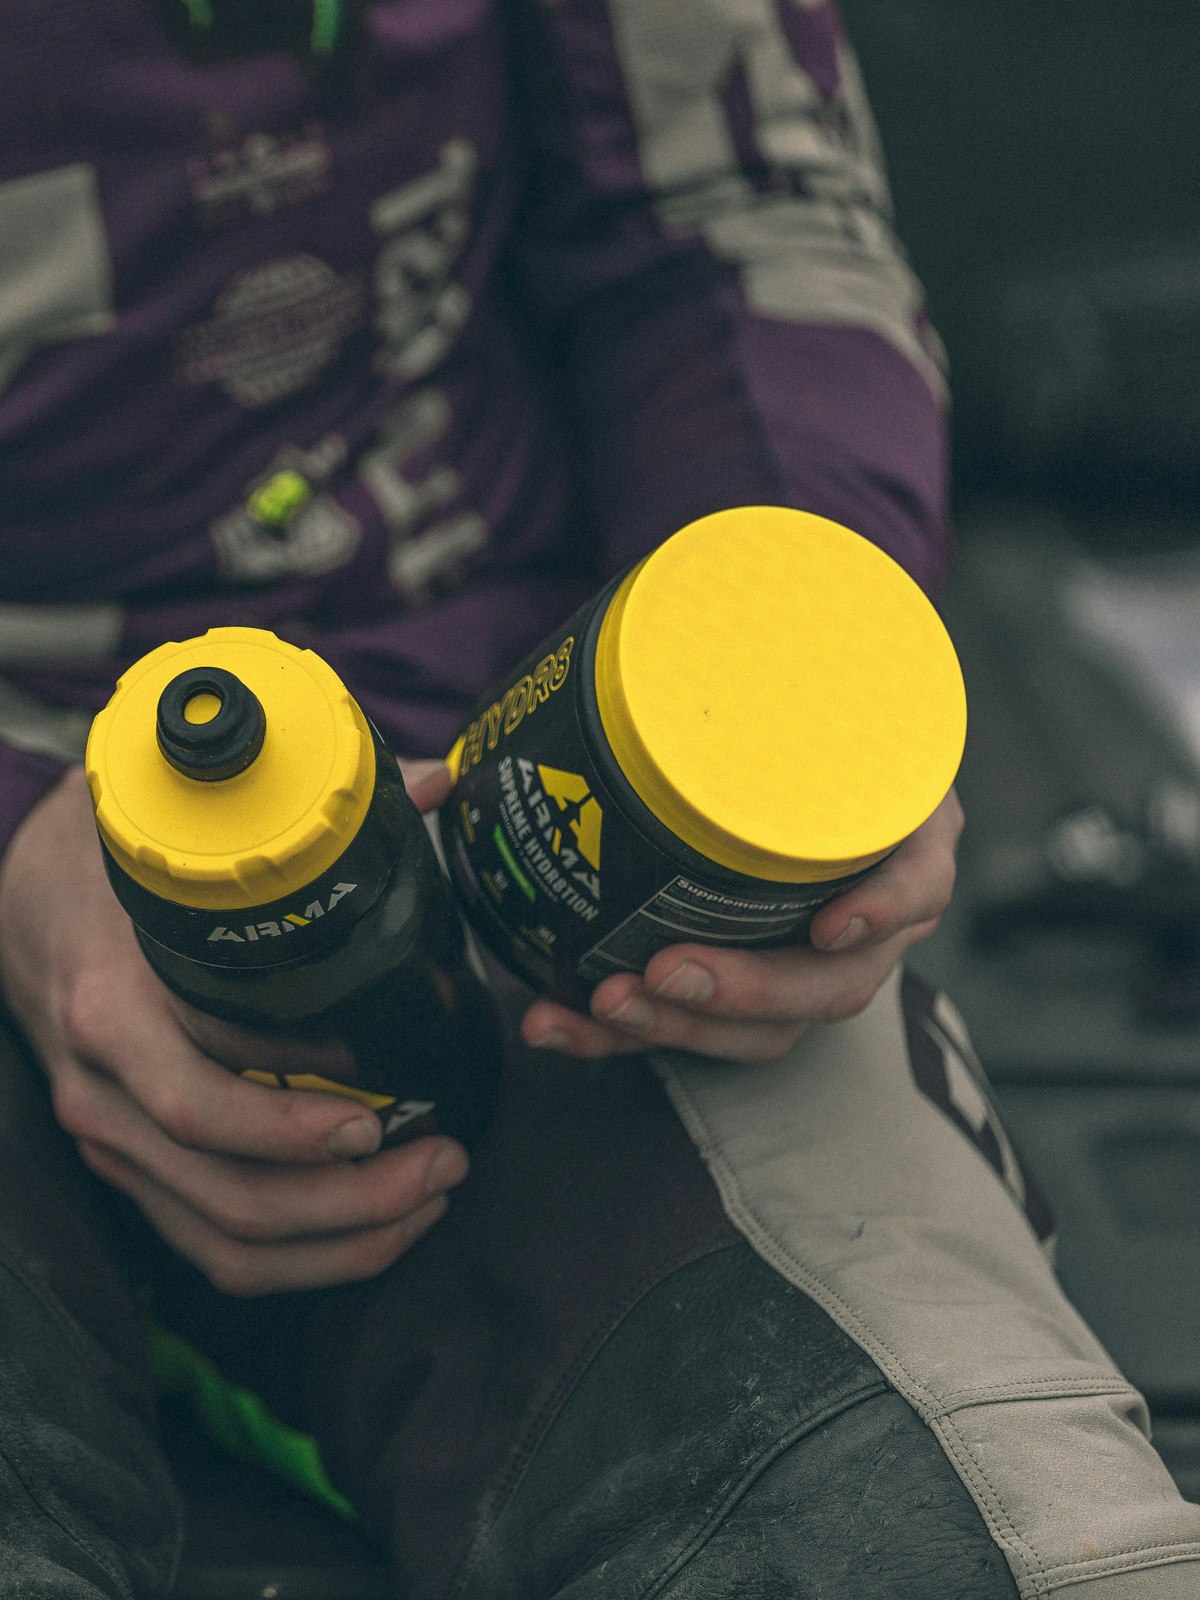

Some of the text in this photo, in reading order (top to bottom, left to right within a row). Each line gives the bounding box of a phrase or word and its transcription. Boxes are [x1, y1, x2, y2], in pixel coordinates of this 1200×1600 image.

[498, 755, 533, 841] SUPREME
[517, 756, 601, 901] ARMA
[206, 882, 358, 942] ARMA
[677, 878, 776, 911] Supplement
